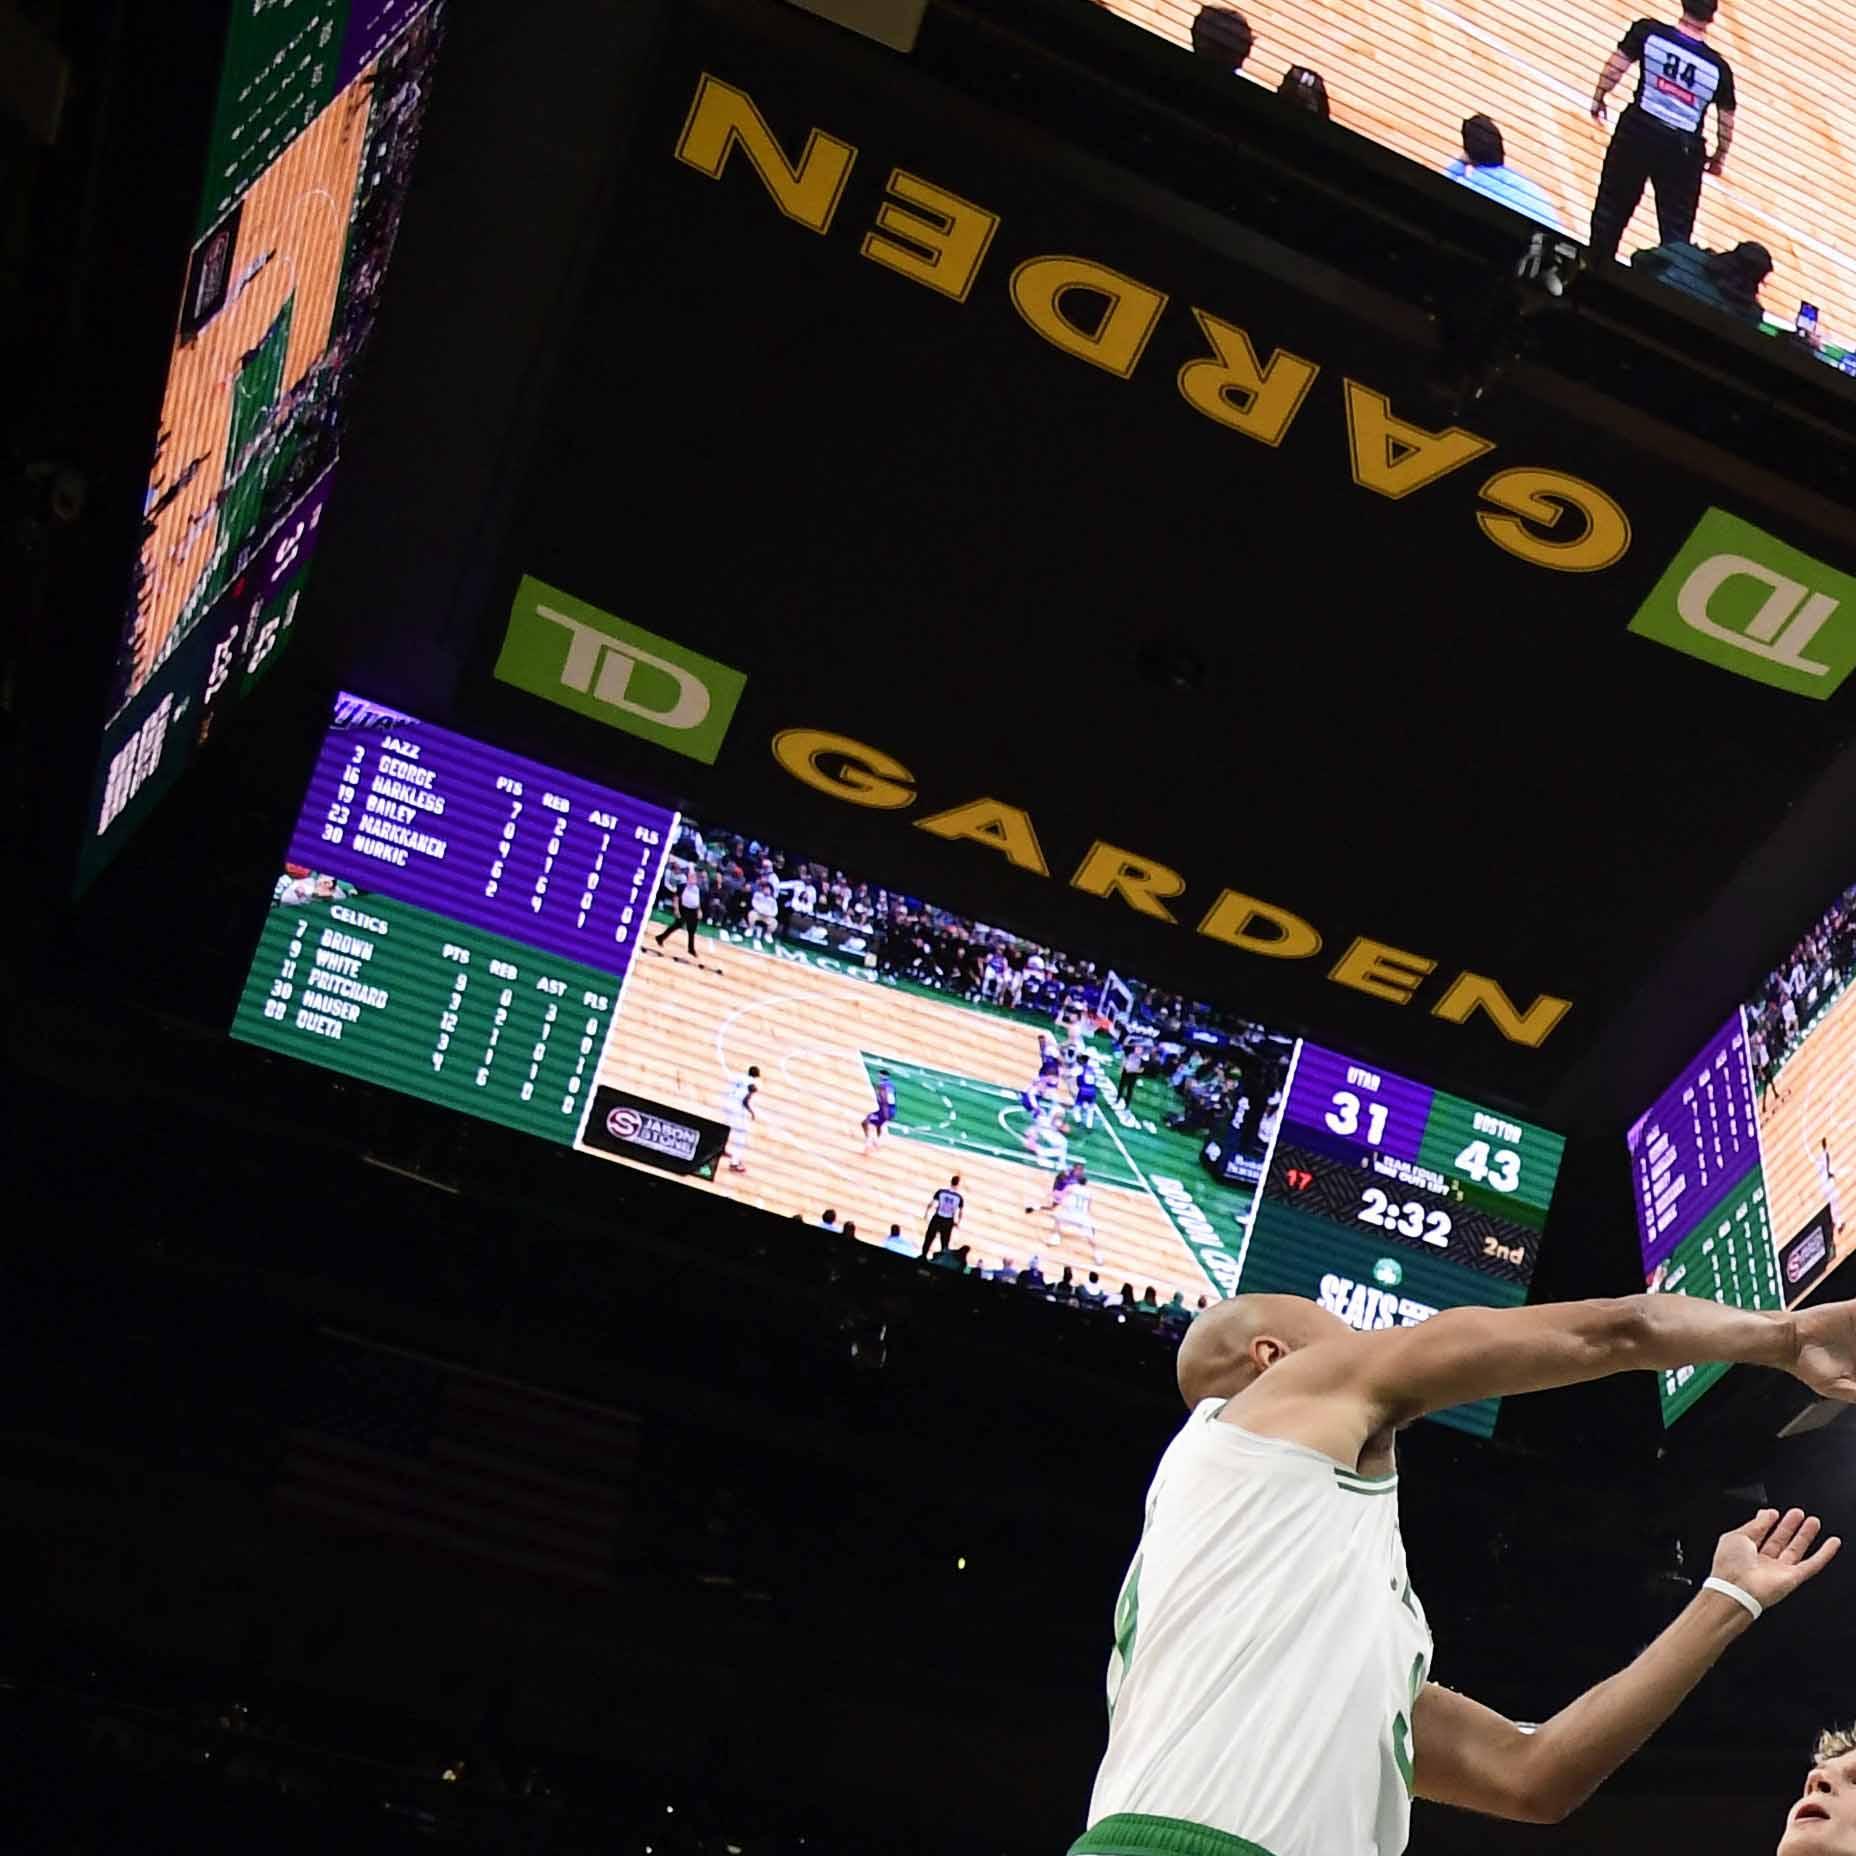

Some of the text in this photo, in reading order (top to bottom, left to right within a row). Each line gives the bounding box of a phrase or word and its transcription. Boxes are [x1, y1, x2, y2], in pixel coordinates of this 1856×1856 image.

[675, 72, 1632, 573] GARDEN
[1676, 552, 1838, 677] TD
[343, 764, 446, 815] 16 HARKLESS
[352, 745, 437, 789] 3 GEORGE
[381, 736, 421, 760] JAZZ
[496, 776, 523, 796] PTS
[589, 810, 618, 830] AST
[634, 826, 659, 845] FLS
[338, 784, 417, 824] 19 BAILEY
[537, 604, 1572, 1048] TD GARDEN
[321, 824, 409, 866] 30 NURKIC
[328, 803, 447, 859] 23 MARKKANEN
[289, 940, 362, 978] 9 WHITE
[296, 919, 374, 960] 7 BROWN
[330, 905, 608, 1011] CELTICS PTS REB AST FLS
[270, 979, 360, 1023] 30 HAUSER
[281, 959, 389, 1009] 11 PRITCHARD
[296, 1009, 343, 1039] QUETA
[1347, 1065, 1380, 1092] UTAH
[1324, 1091, 1389, 1145] 31
[1472, 1111, 1522, 1144] BOSTON
[1287, 1169, 1313, 1190] 17
[1454, 1140, 1521, 1192] 43
[1358, 1188, 1452, 1248] 2:32
[1484, 1236, 1525, 1264] 2nd
[1316, 1273, 1394, 1331] SEATS
